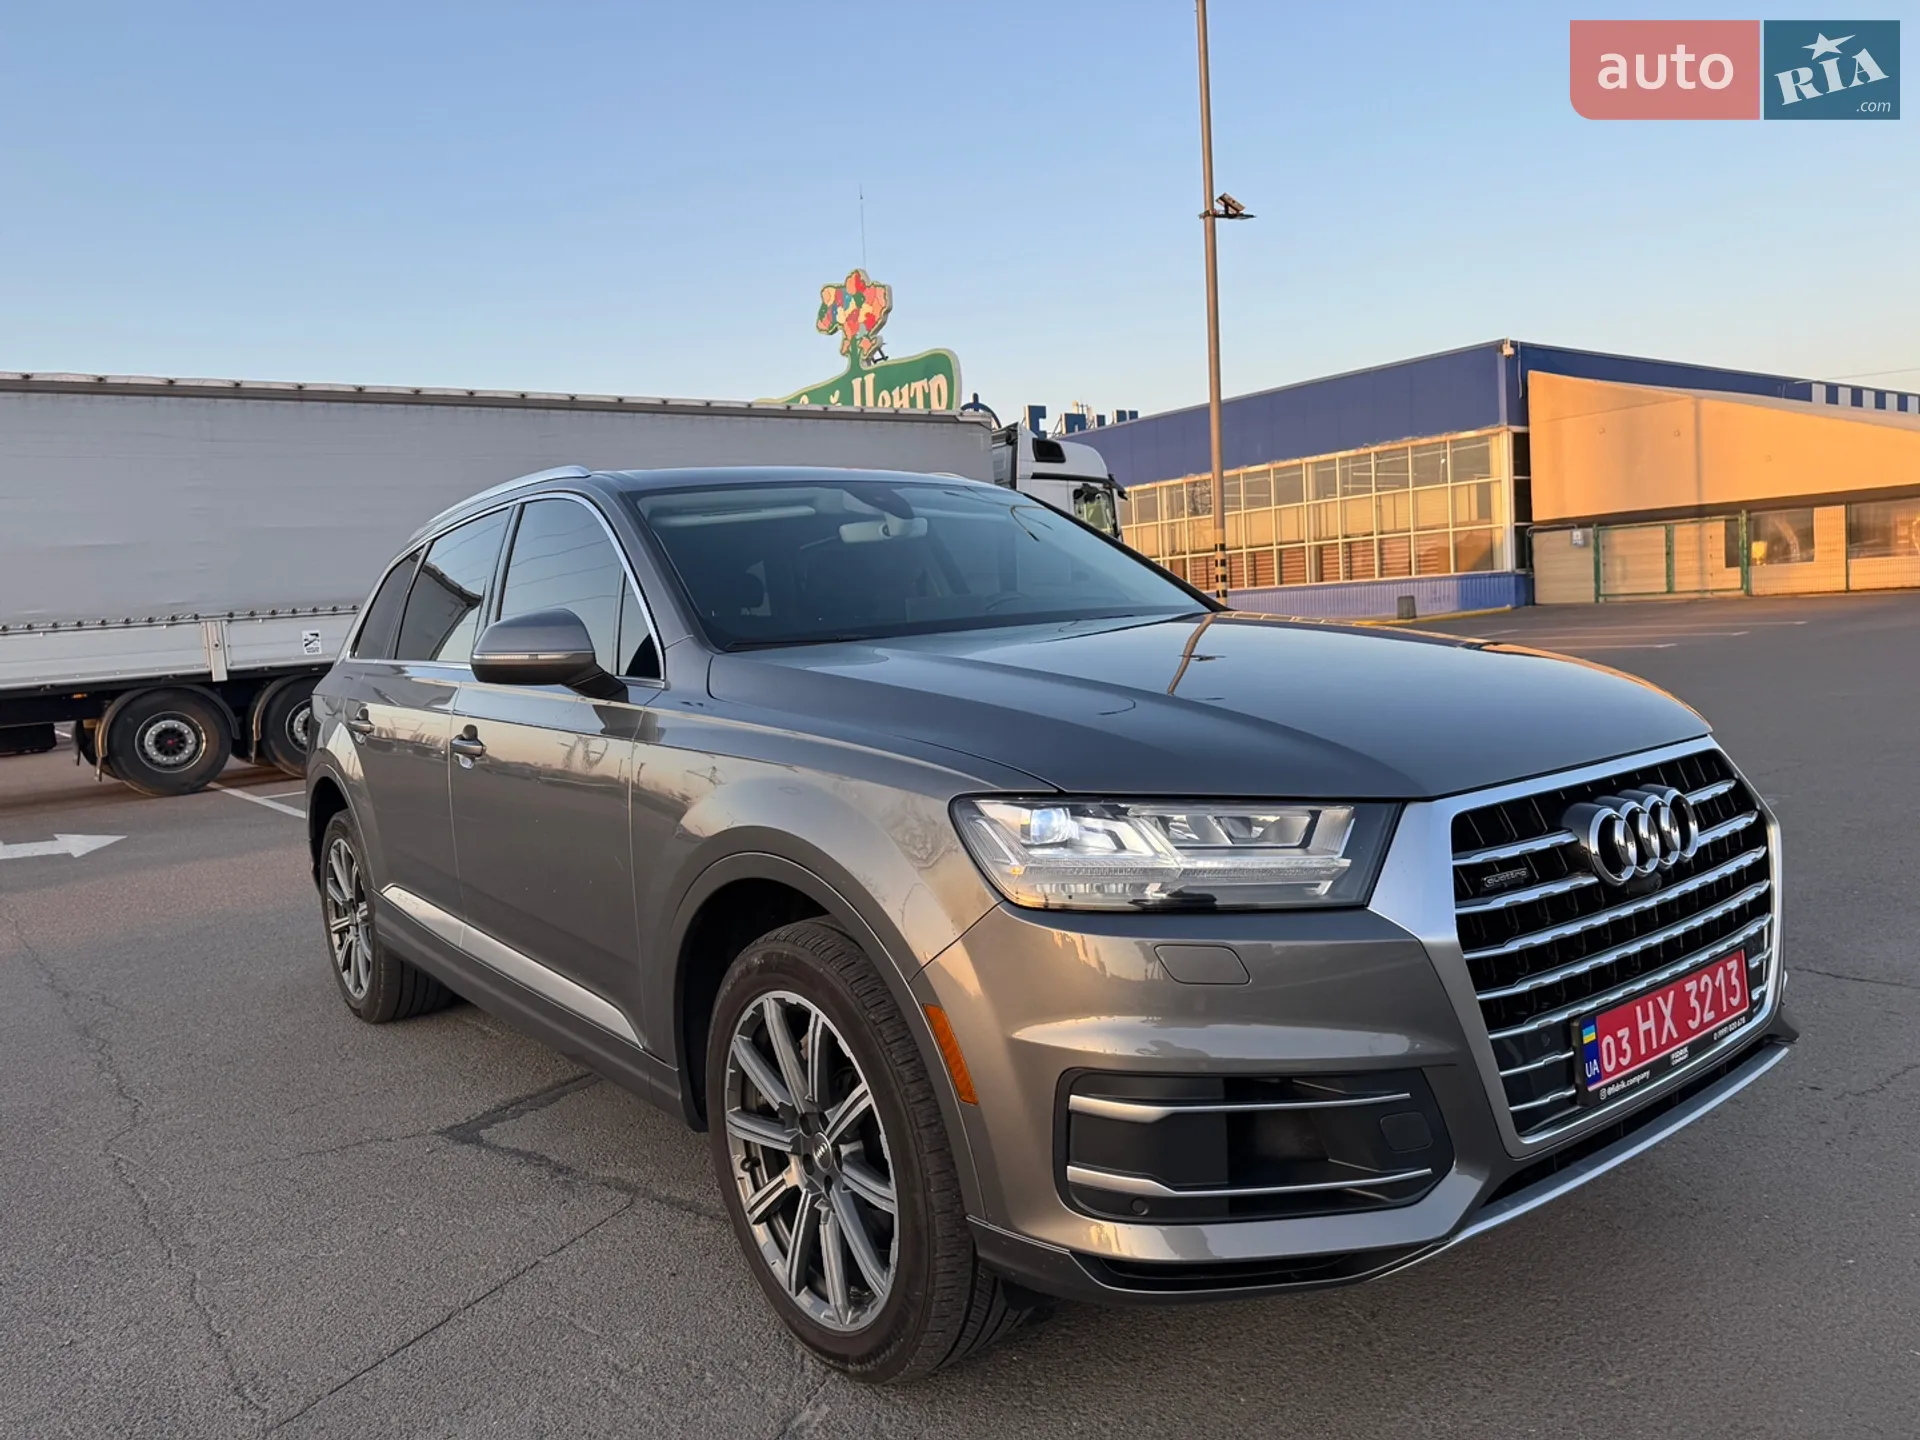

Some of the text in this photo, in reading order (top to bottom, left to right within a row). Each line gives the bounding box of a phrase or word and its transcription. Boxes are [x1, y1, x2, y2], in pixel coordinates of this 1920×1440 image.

[1601, 958, 1742, 1073] 03 HX 3213
[1585, 1058, 1600, 1079] UA
